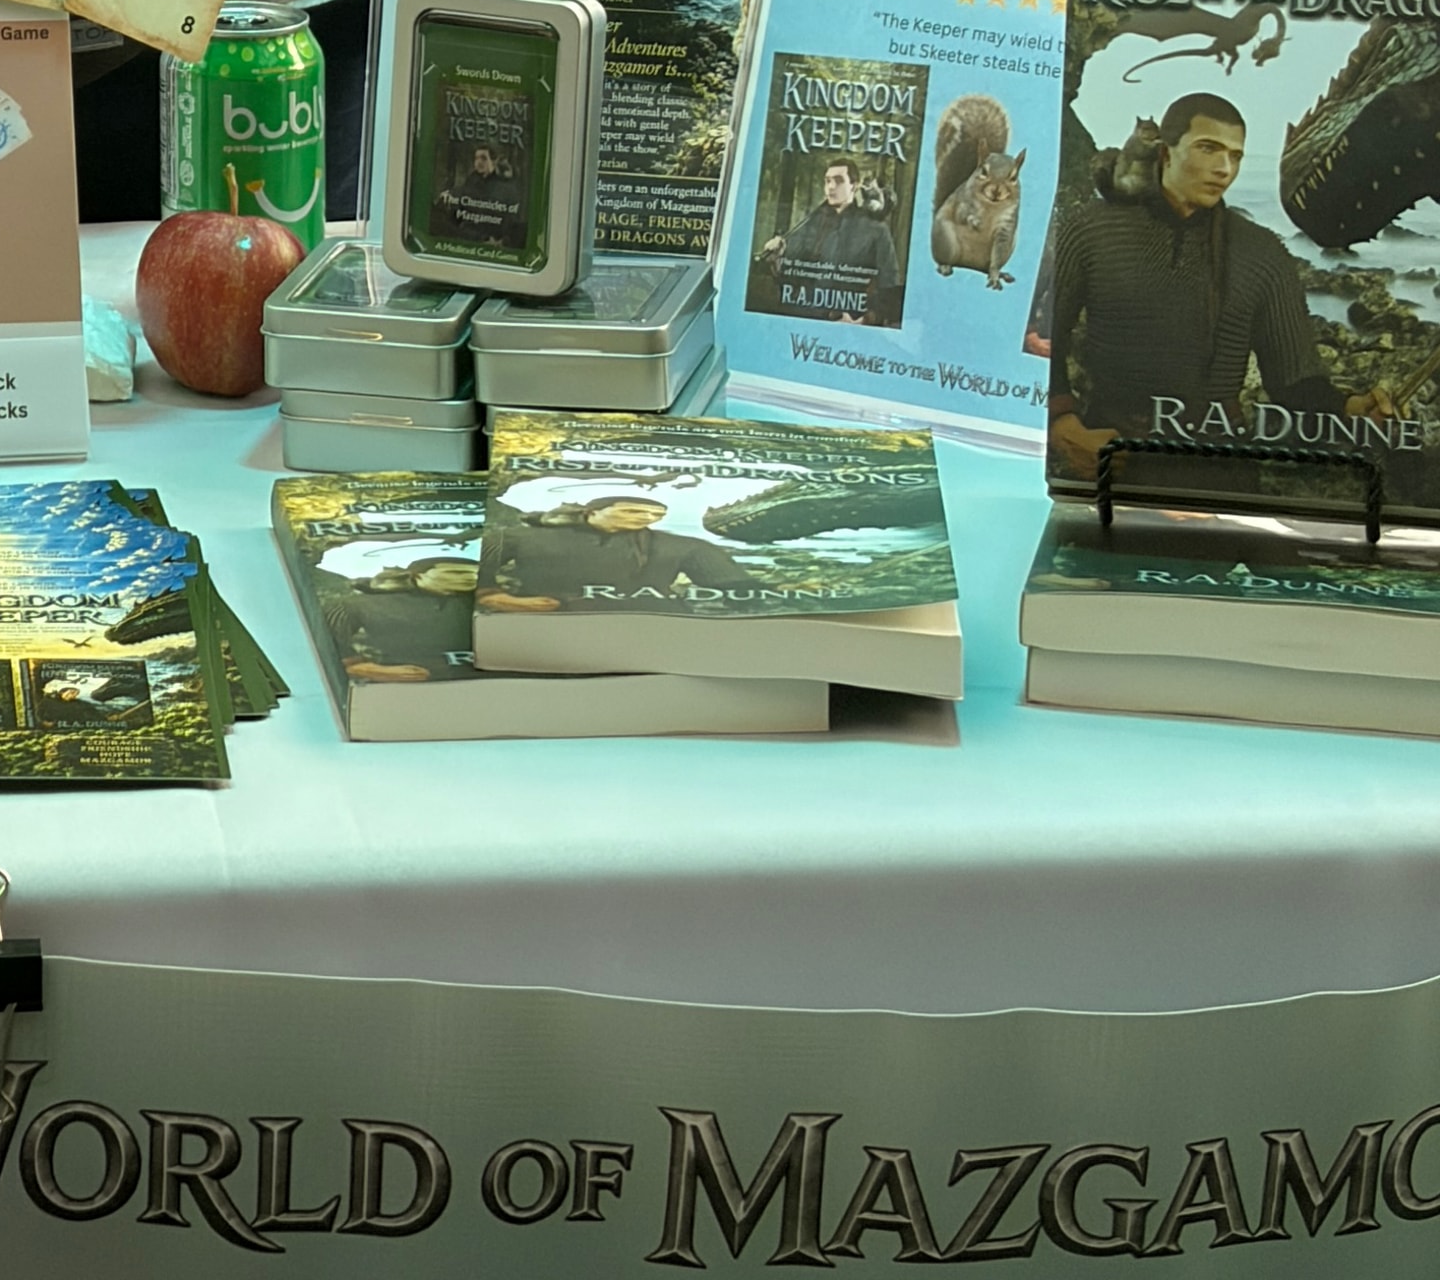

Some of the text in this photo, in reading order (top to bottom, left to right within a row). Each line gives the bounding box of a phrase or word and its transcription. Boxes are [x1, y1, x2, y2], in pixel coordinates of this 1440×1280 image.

[0, 25, 49, 42] Game
[913, 18, 968, 40] Keeper
[972, 28, 1006, 48] may
[1010, 33, 1052, 52] wield
[456, 64, 521, 84] Swords Down
[889, 38, 1061, 79] but Skeeter steals the
[446, 92, 529, 121] KINGDOM
[781, 71, 918, 116] KINGDOM
[450, 117, 524, 149] KEEPER
[786, 113, 907, 163] KEEPER
[814, 286, 868, 313] DUNNE
[791, 332, 1010, 397] WELCOME WORLD
[1252, 403, 1423, 452] DUNNE
[711, 463, 928, 487] DRAGONS
[685, 584, 855, 602] DUNNE
[1233, 575, 1419, 600] DUNNE
[480, 1136, 635, 1226] OF
